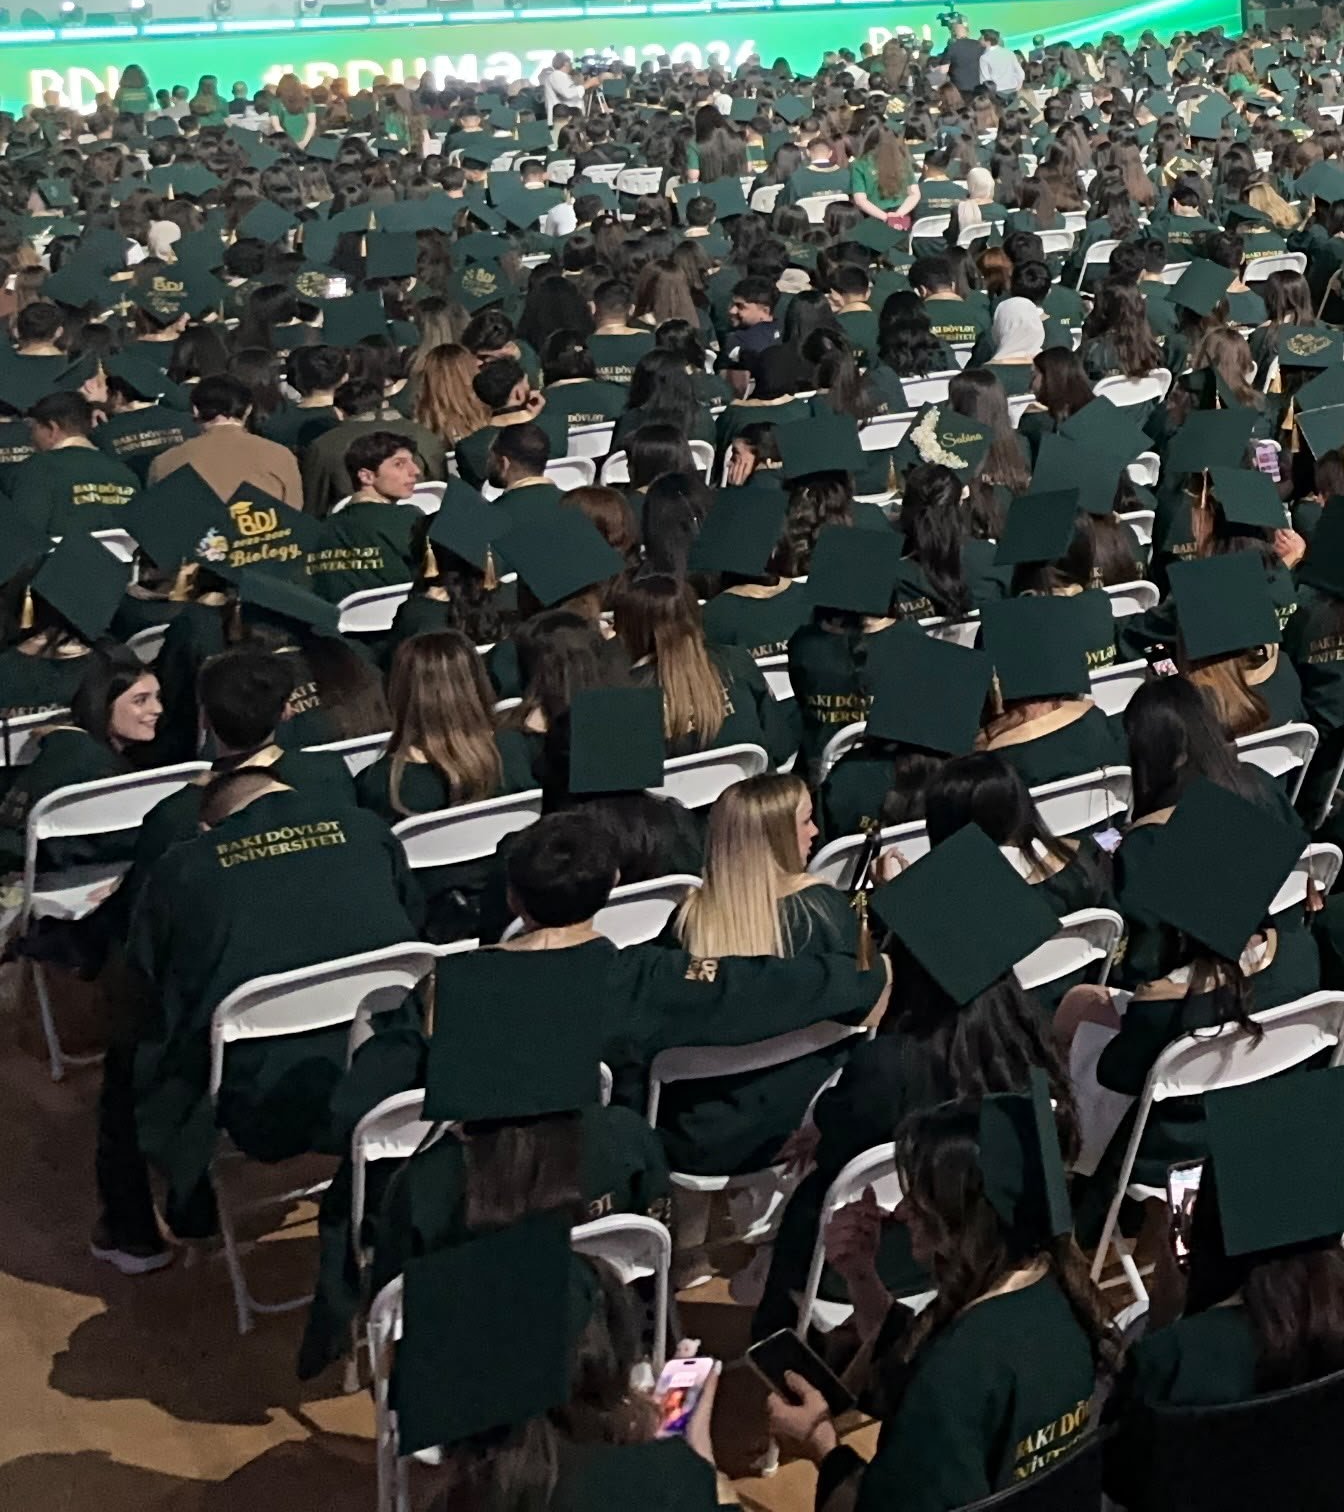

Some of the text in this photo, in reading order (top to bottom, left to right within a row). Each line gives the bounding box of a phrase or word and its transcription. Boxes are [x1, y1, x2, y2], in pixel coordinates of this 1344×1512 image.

[216, 820, 341, 855] BAKI DÖVLƏT
[220, 832, 347, 868] UNİVERSİTETİ
